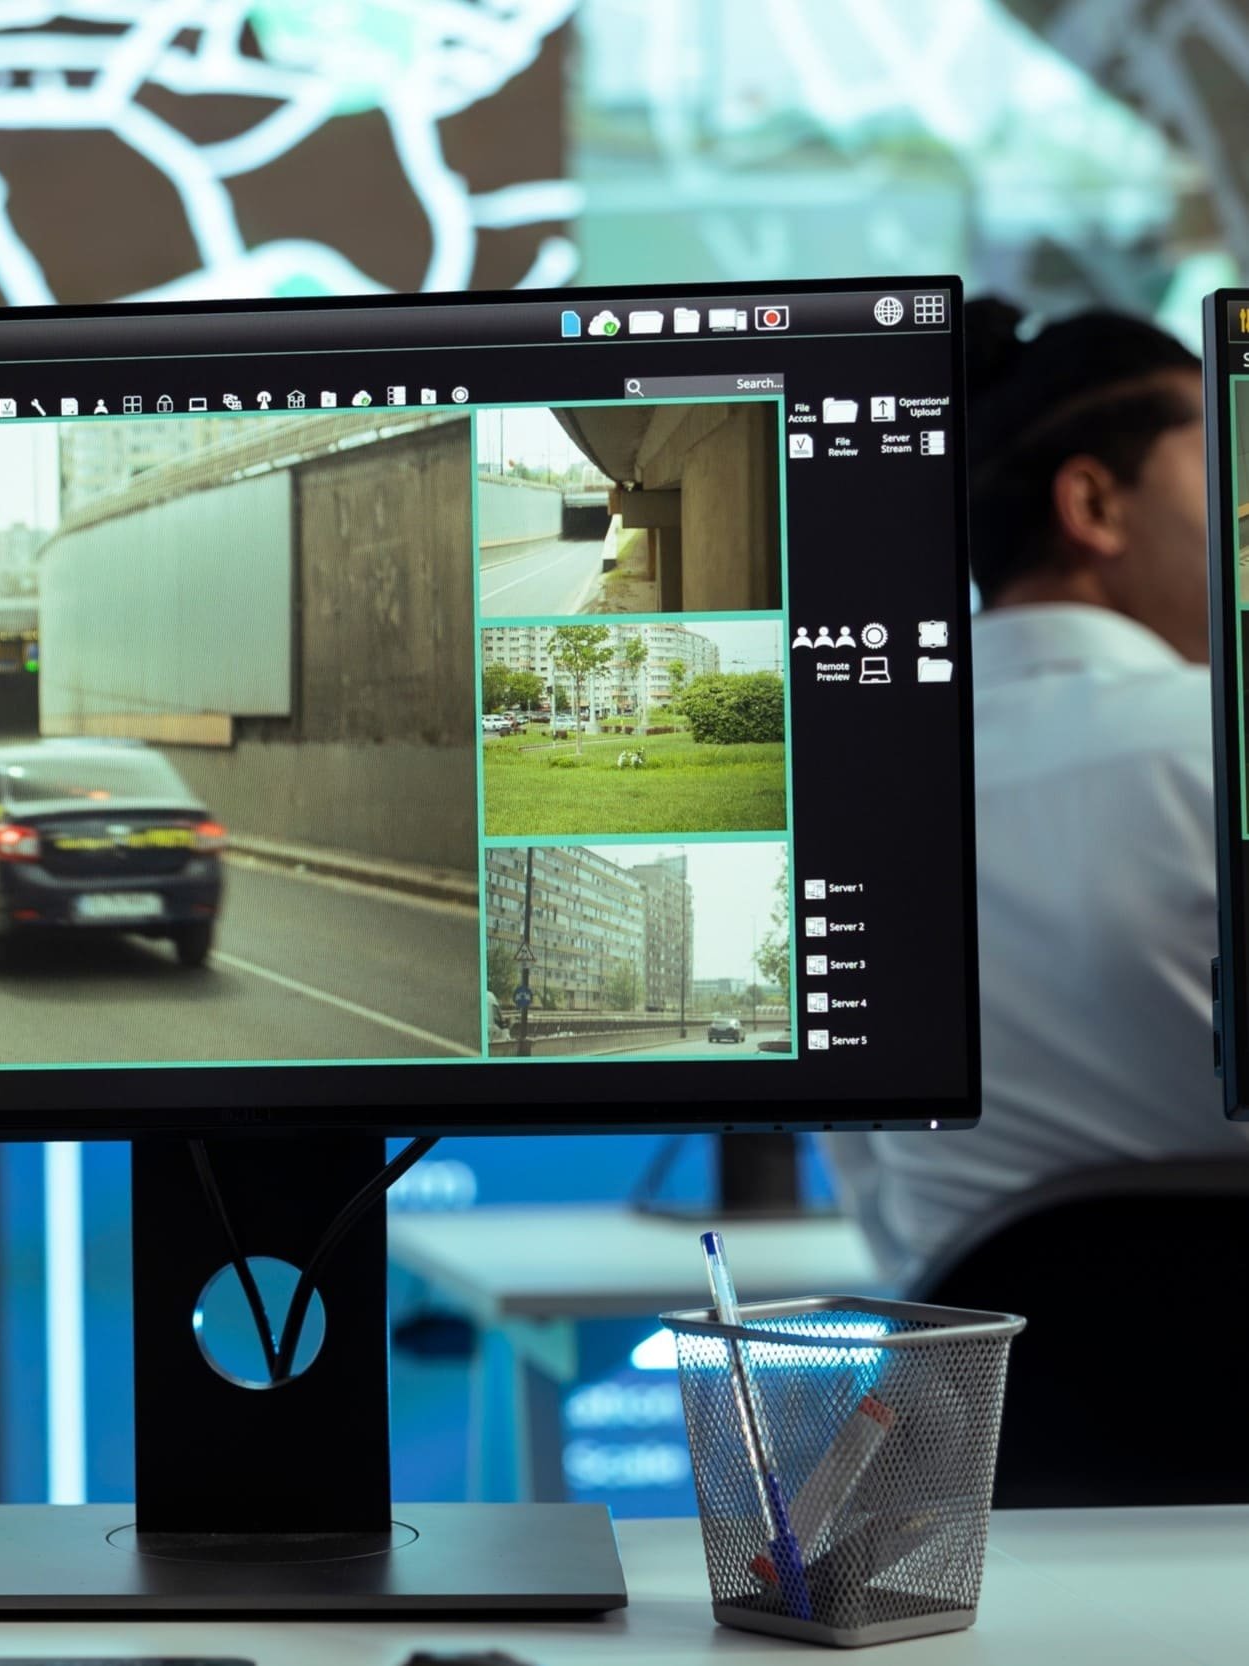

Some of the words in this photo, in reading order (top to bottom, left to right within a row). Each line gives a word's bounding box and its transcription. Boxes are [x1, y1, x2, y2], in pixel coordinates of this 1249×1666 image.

[898, 396, 950, 407] Operational
[794, 403, 810, 413] File
[909, 407, 942, 418] Upload
[787, 414, 817, 423] Access
[835, 437, 851, 446] File
[882, 433, 910, 443] Server
[828, 447, 859, 457] Review
[880, 444, 912, 454] Stream
[816, 662, 850, 671] Remote
[816, 672, 850, 681] Preview
[829, 883, 857, 892] Server
[858, 883, 864, 892] 1
[829, 922, 858, 932] Server
[858, 922, 865, 931] 2
[830, 960, 859, 969] Server
[859, 960, 866, 969] 3
[831, 999, 860, 1008] Server
[860, 999, 867, 1008] 4
[832, 1036, 860, 1046] Server
[861, 1036, 867, 1045] 5
